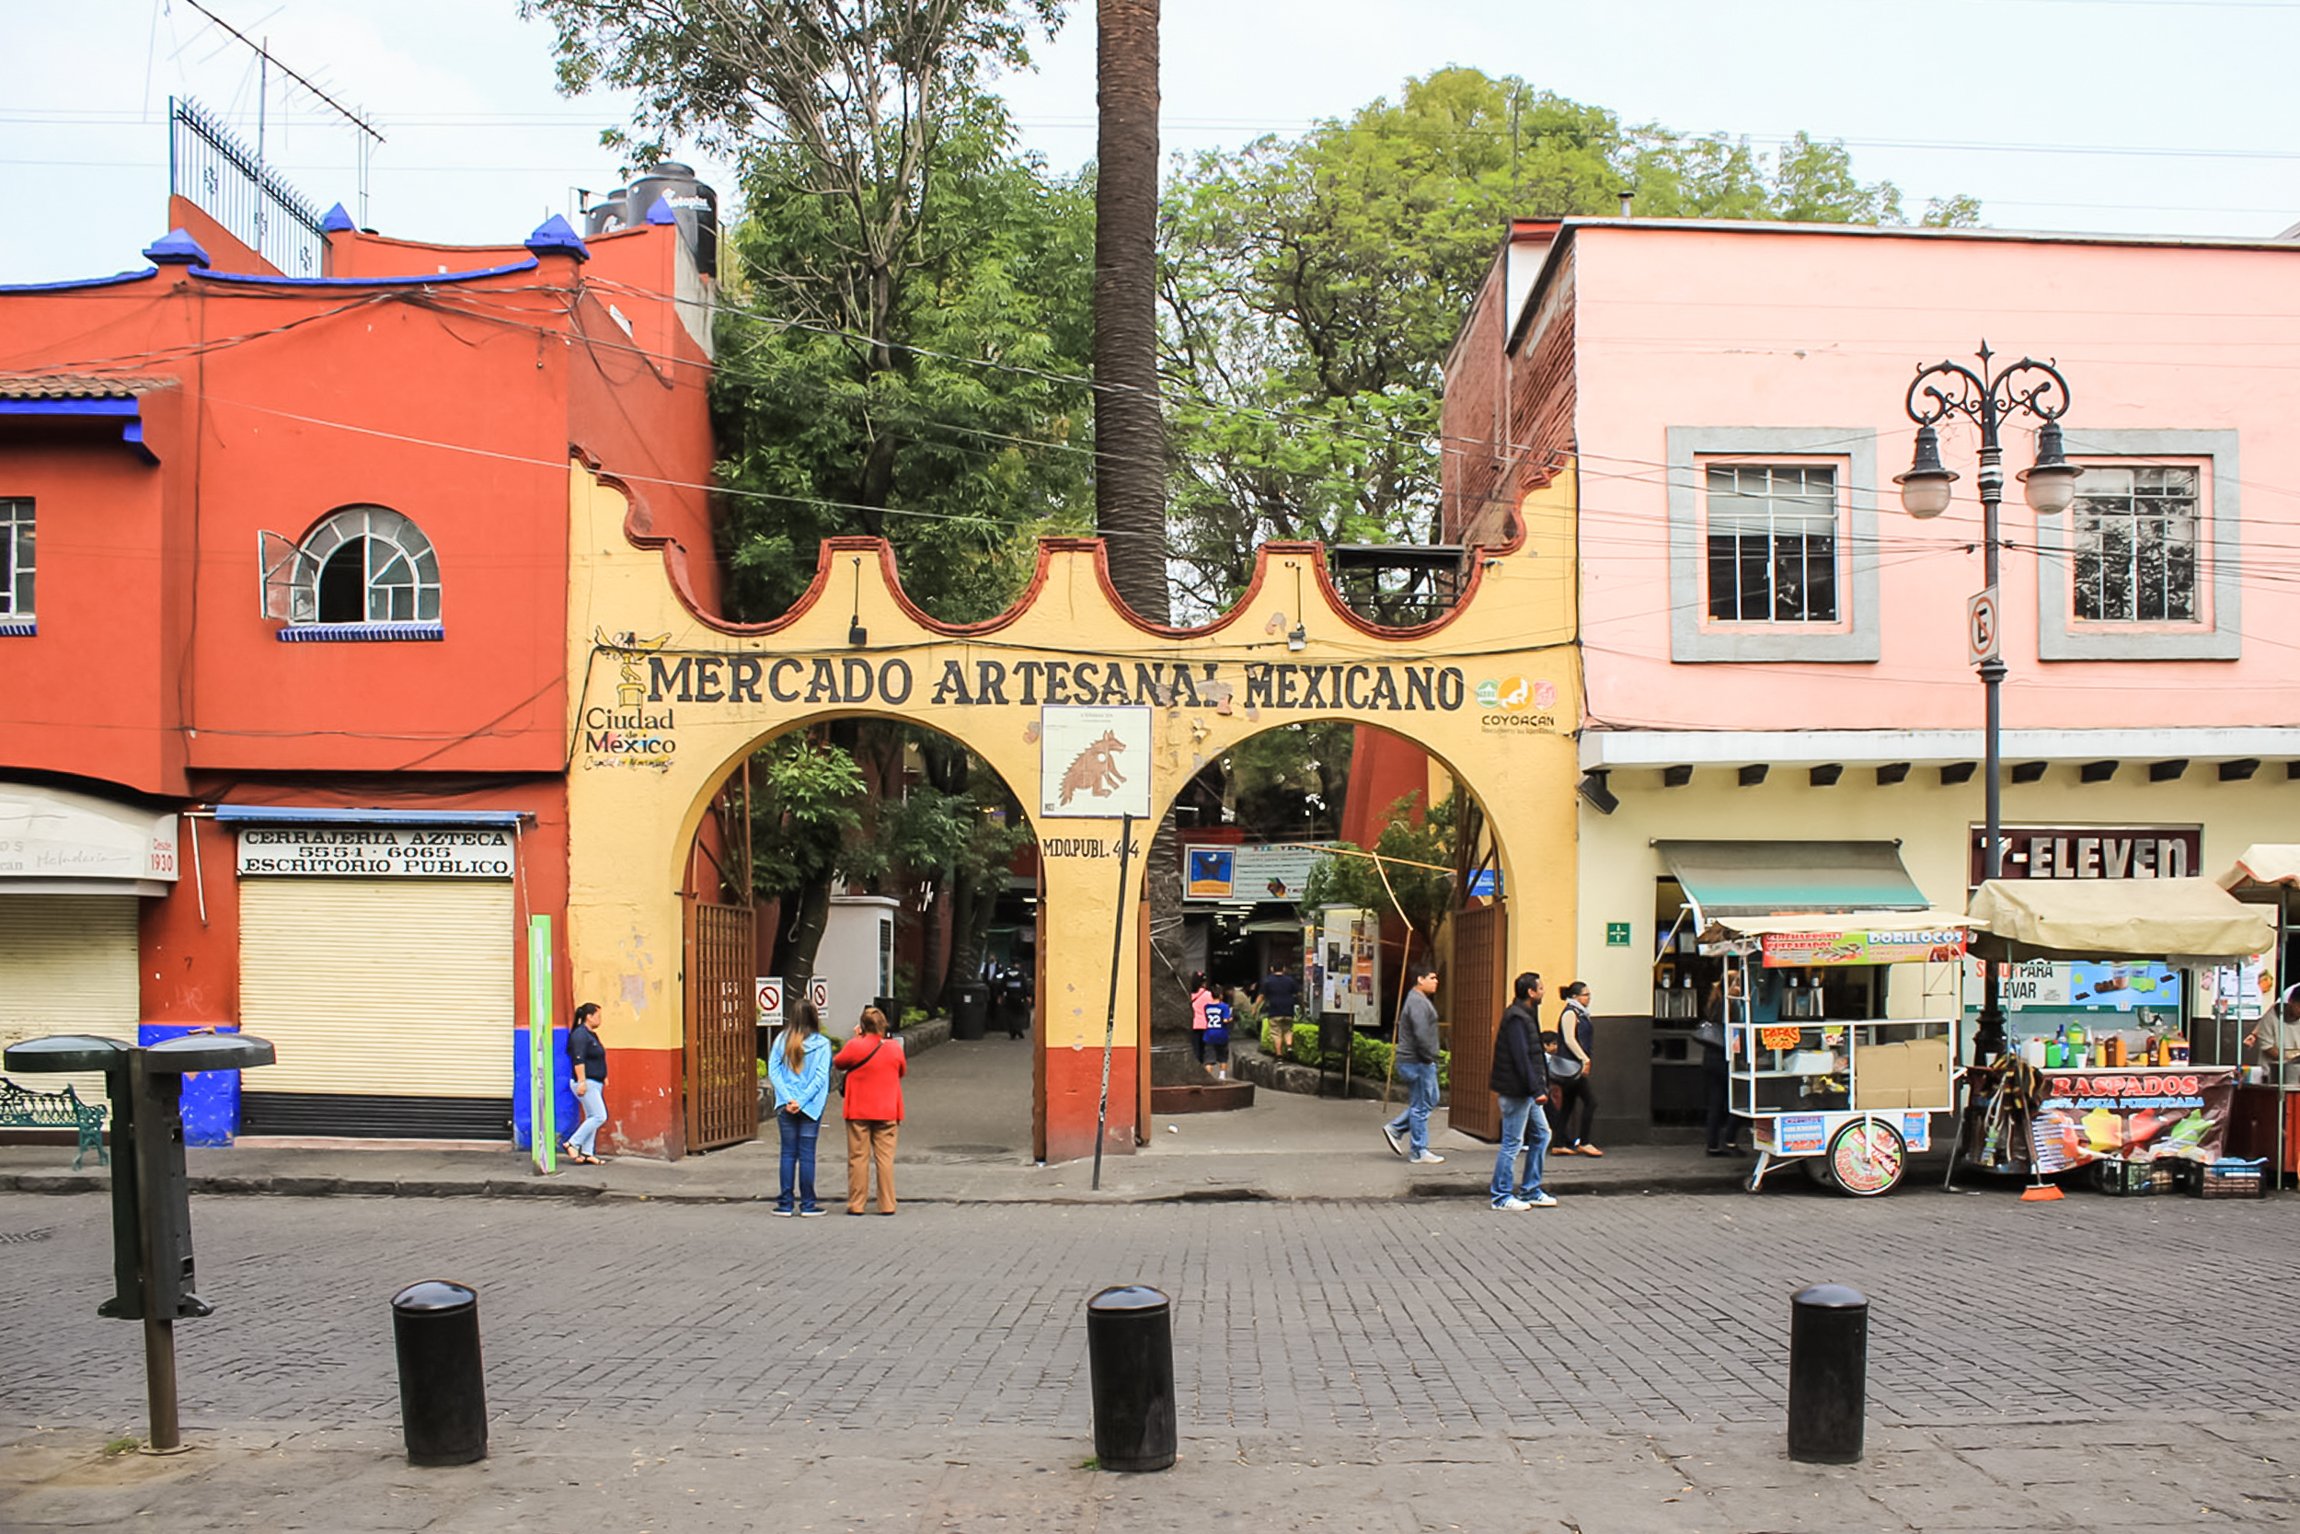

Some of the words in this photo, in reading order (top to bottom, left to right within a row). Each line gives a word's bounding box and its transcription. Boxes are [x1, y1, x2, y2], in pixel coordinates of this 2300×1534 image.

[647, 656, 913, 705] MERCADO
[1244, 662, 1465, 712] MEXICANO
[586, 707, 674, 730] Ciudad
[586, 731, 676, 754] México
[245, 831, 398, 846] CERRAJERIA
[410, 832, 507, 846] AZTECA
[386, 847, 452, 858] 6065
[151, 853, 174, 872] 1930
[245, 858, 391, 873] ESCRITORIO
[403, 860, 508, 874] PUBLICO
[1868, 931, 1963, 945] DORILOCOS
[1207, 1015, 1221, 1028] 22
[2051, 1076, 2198, 1097] RASPADOS
[2075, 1098, 2117, 1109] AGUA
